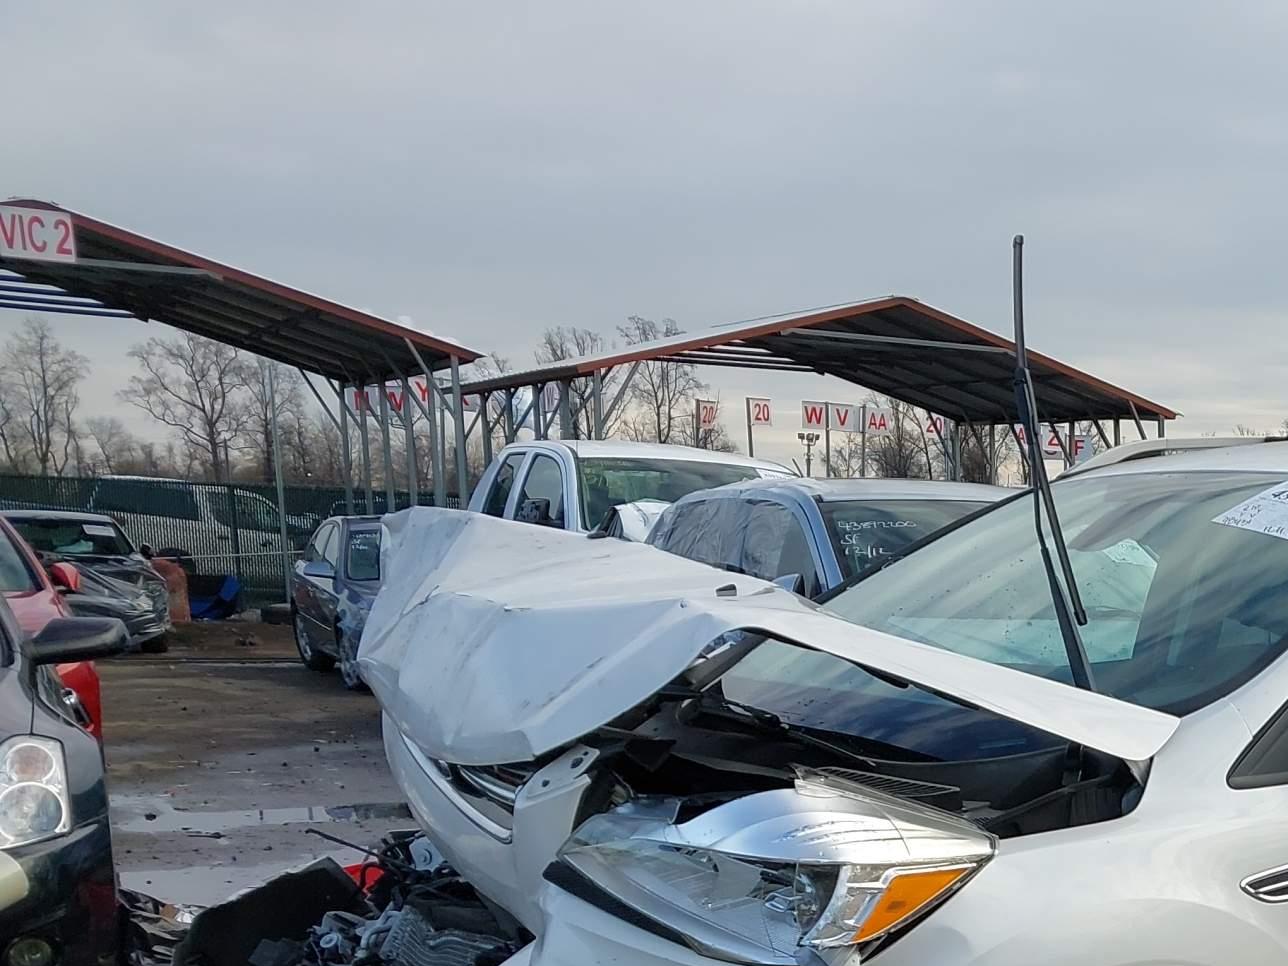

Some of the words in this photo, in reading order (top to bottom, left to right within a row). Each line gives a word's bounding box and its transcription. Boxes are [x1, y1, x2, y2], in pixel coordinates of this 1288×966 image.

[0, 213, 47, 253] VIC
[54, 219, 72, 255] 2
[754, 404, 770, 421] 20
[804, 406, 823, 424] W
[835, 408, 849, 426] V
[868, 412, 887, 430] AA
[926, 416, 943, 433] 20
